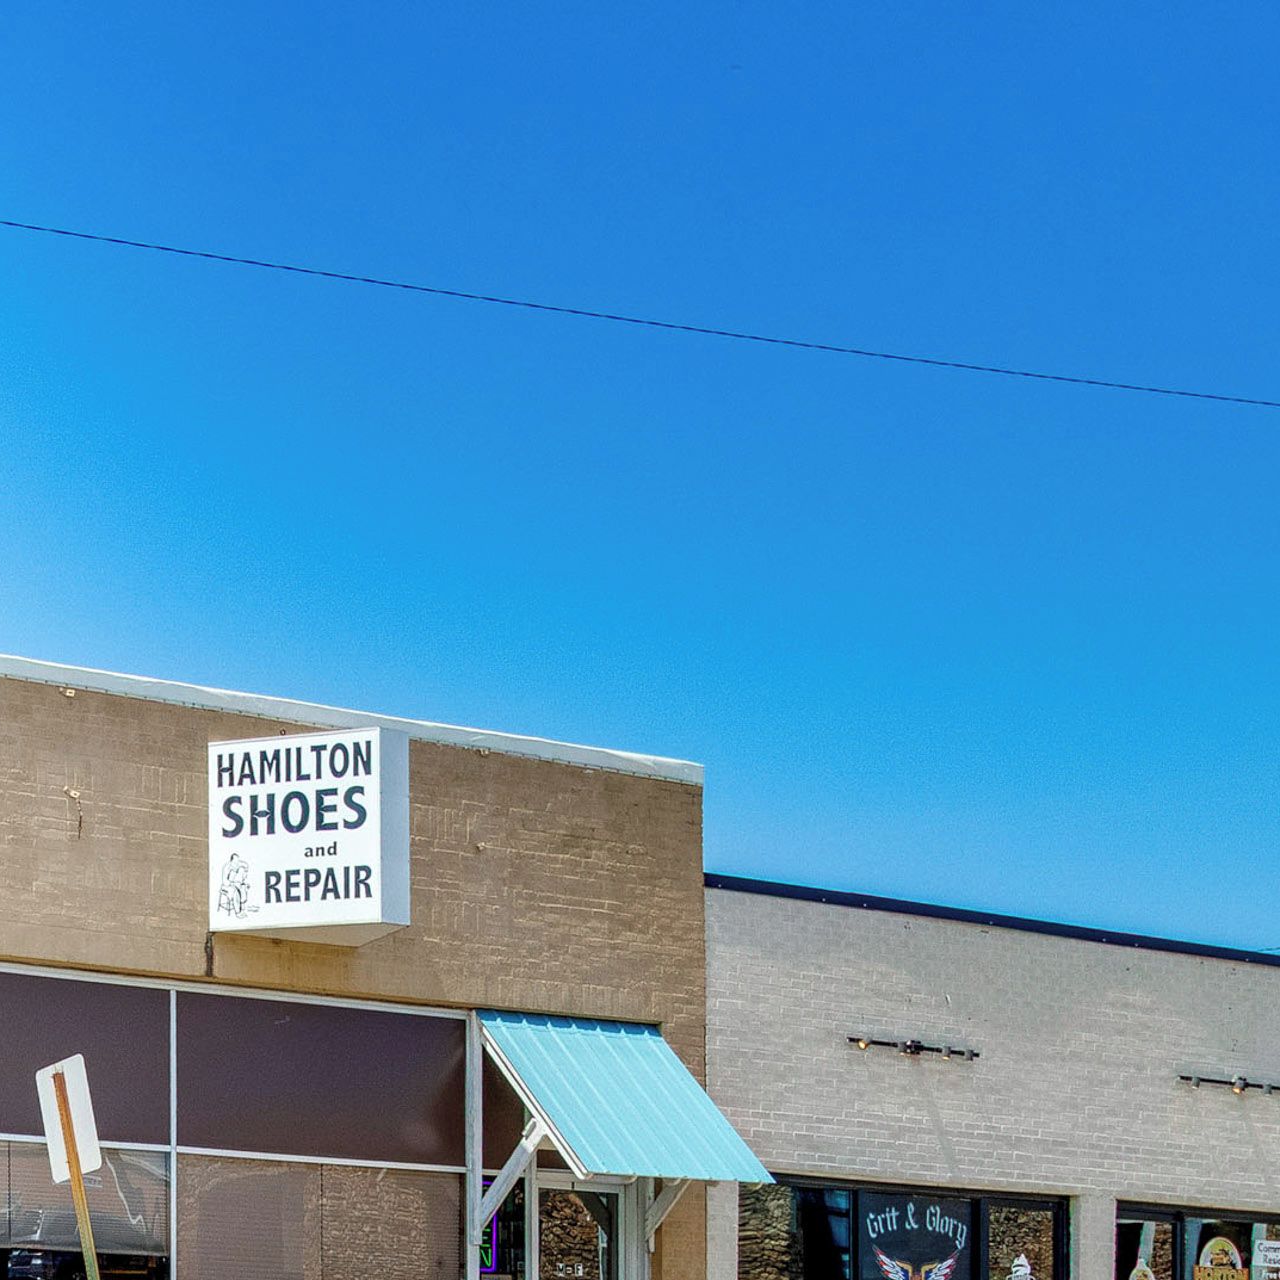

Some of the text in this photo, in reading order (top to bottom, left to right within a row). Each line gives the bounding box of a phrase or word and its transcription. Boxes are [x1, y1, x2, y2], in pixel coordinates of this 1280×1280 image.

[217, 740, 372, 788] HAMILTON
[221, 785, 368, 838] SHOES
[304, 841, 338, 858] and
[264, 865, 373, 904] REPAIR
[866, 1202, 968, 1250] Grit & Glory
